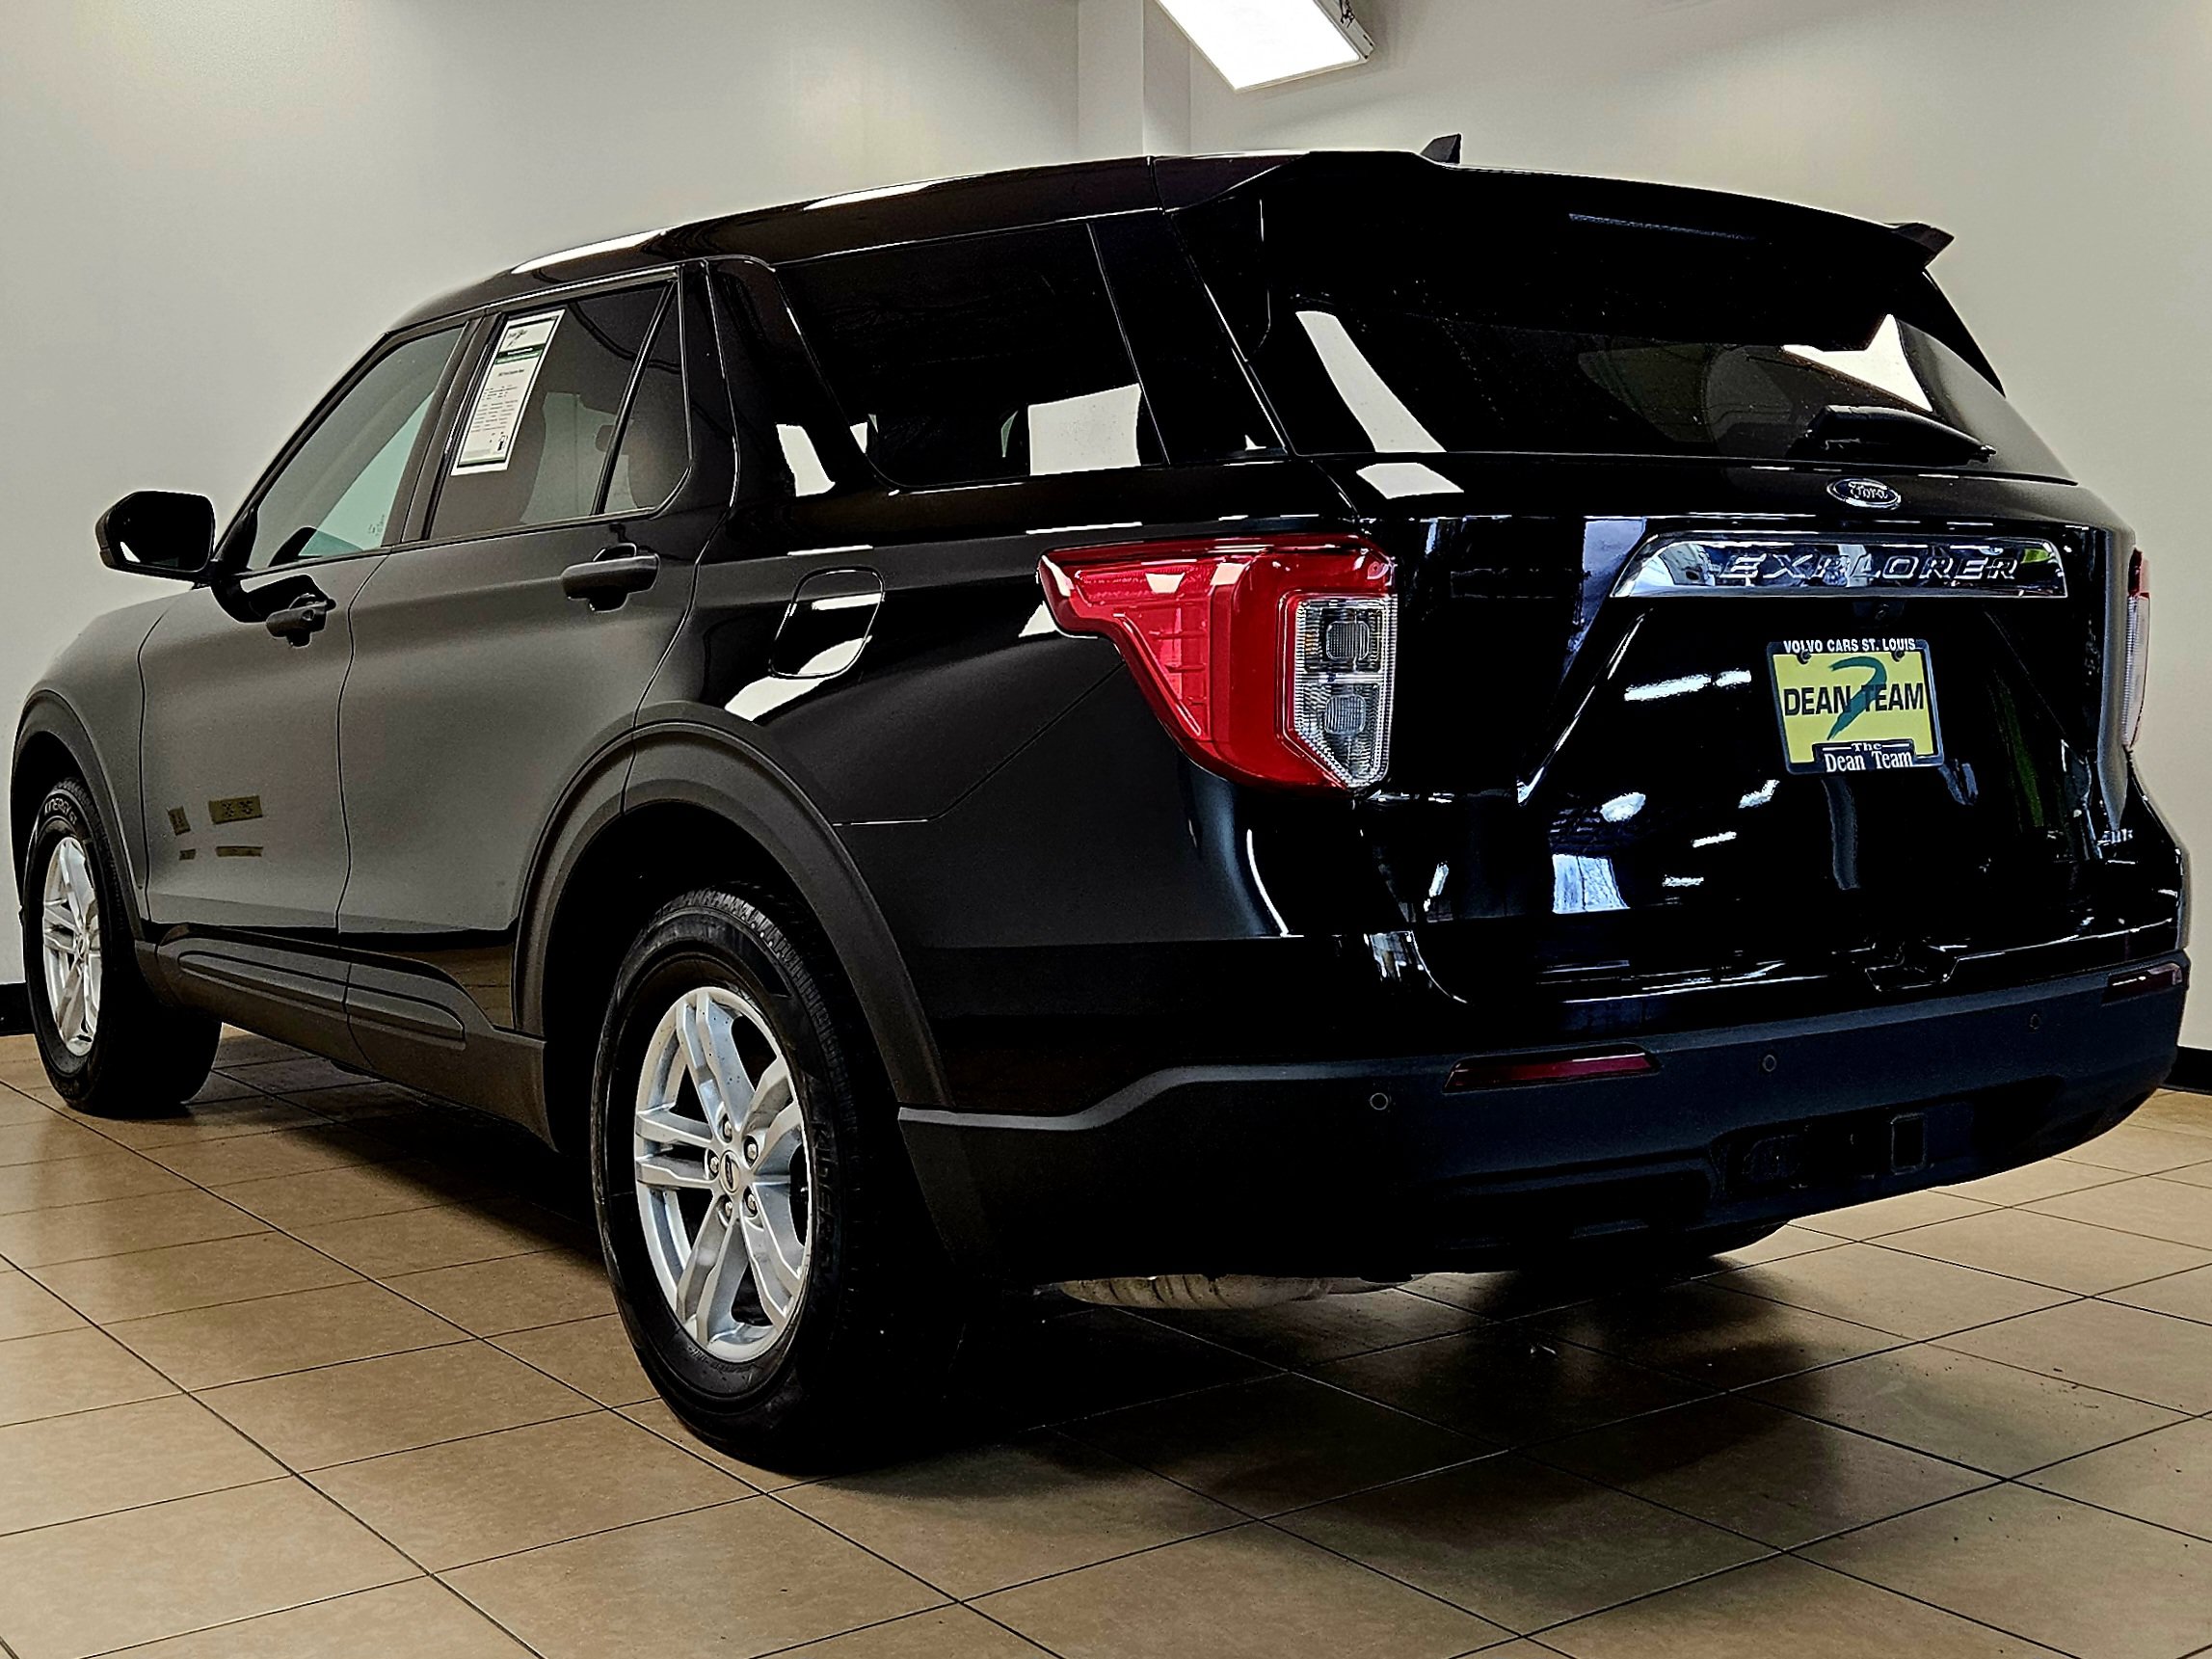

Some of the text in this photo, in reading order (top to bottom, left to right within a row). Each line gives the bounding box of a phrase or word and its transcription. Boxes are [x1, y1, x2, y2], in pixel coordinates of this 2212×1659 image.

[1719, 552, 2019, 580] EXPLORER
[1783, 638, 1916, 654] VOLVO CARS ST. LOUIS
[1783, 682, 1924, 716] DEAN TEAM
[1851, 742, 1882, 752] The
[1824, 751, 1913, 772] Dean Team
